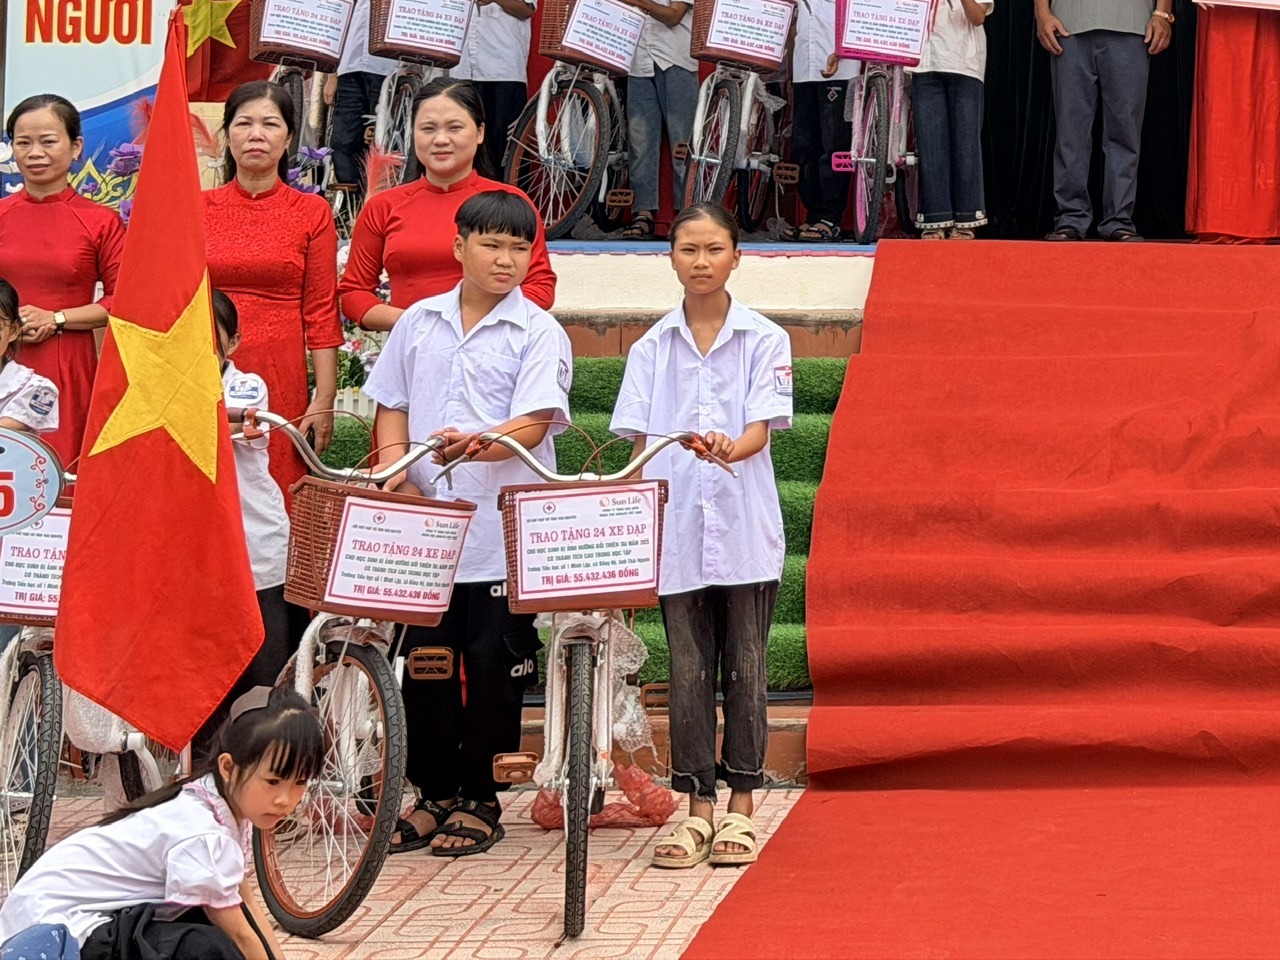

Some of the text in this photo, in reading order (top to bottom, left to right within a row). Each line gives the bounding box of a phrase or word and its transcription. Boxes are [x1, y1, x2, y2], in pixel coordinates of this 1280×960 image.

[530, 531, 558, 543] TRAO
[561, 527, 590, 543] TẶNG
[594, 527, 605, 537] 24
[609, 526, 624, 536] XE
[11, 546, 40, 558] TRAO
[352, 540, 380, 553] TRAO
[383, 542, 409, 556] TẶNG
[412, 547, 423, 557] 24
[425, 548, 439, 559] XE
[490, 582, 507, 597] al
